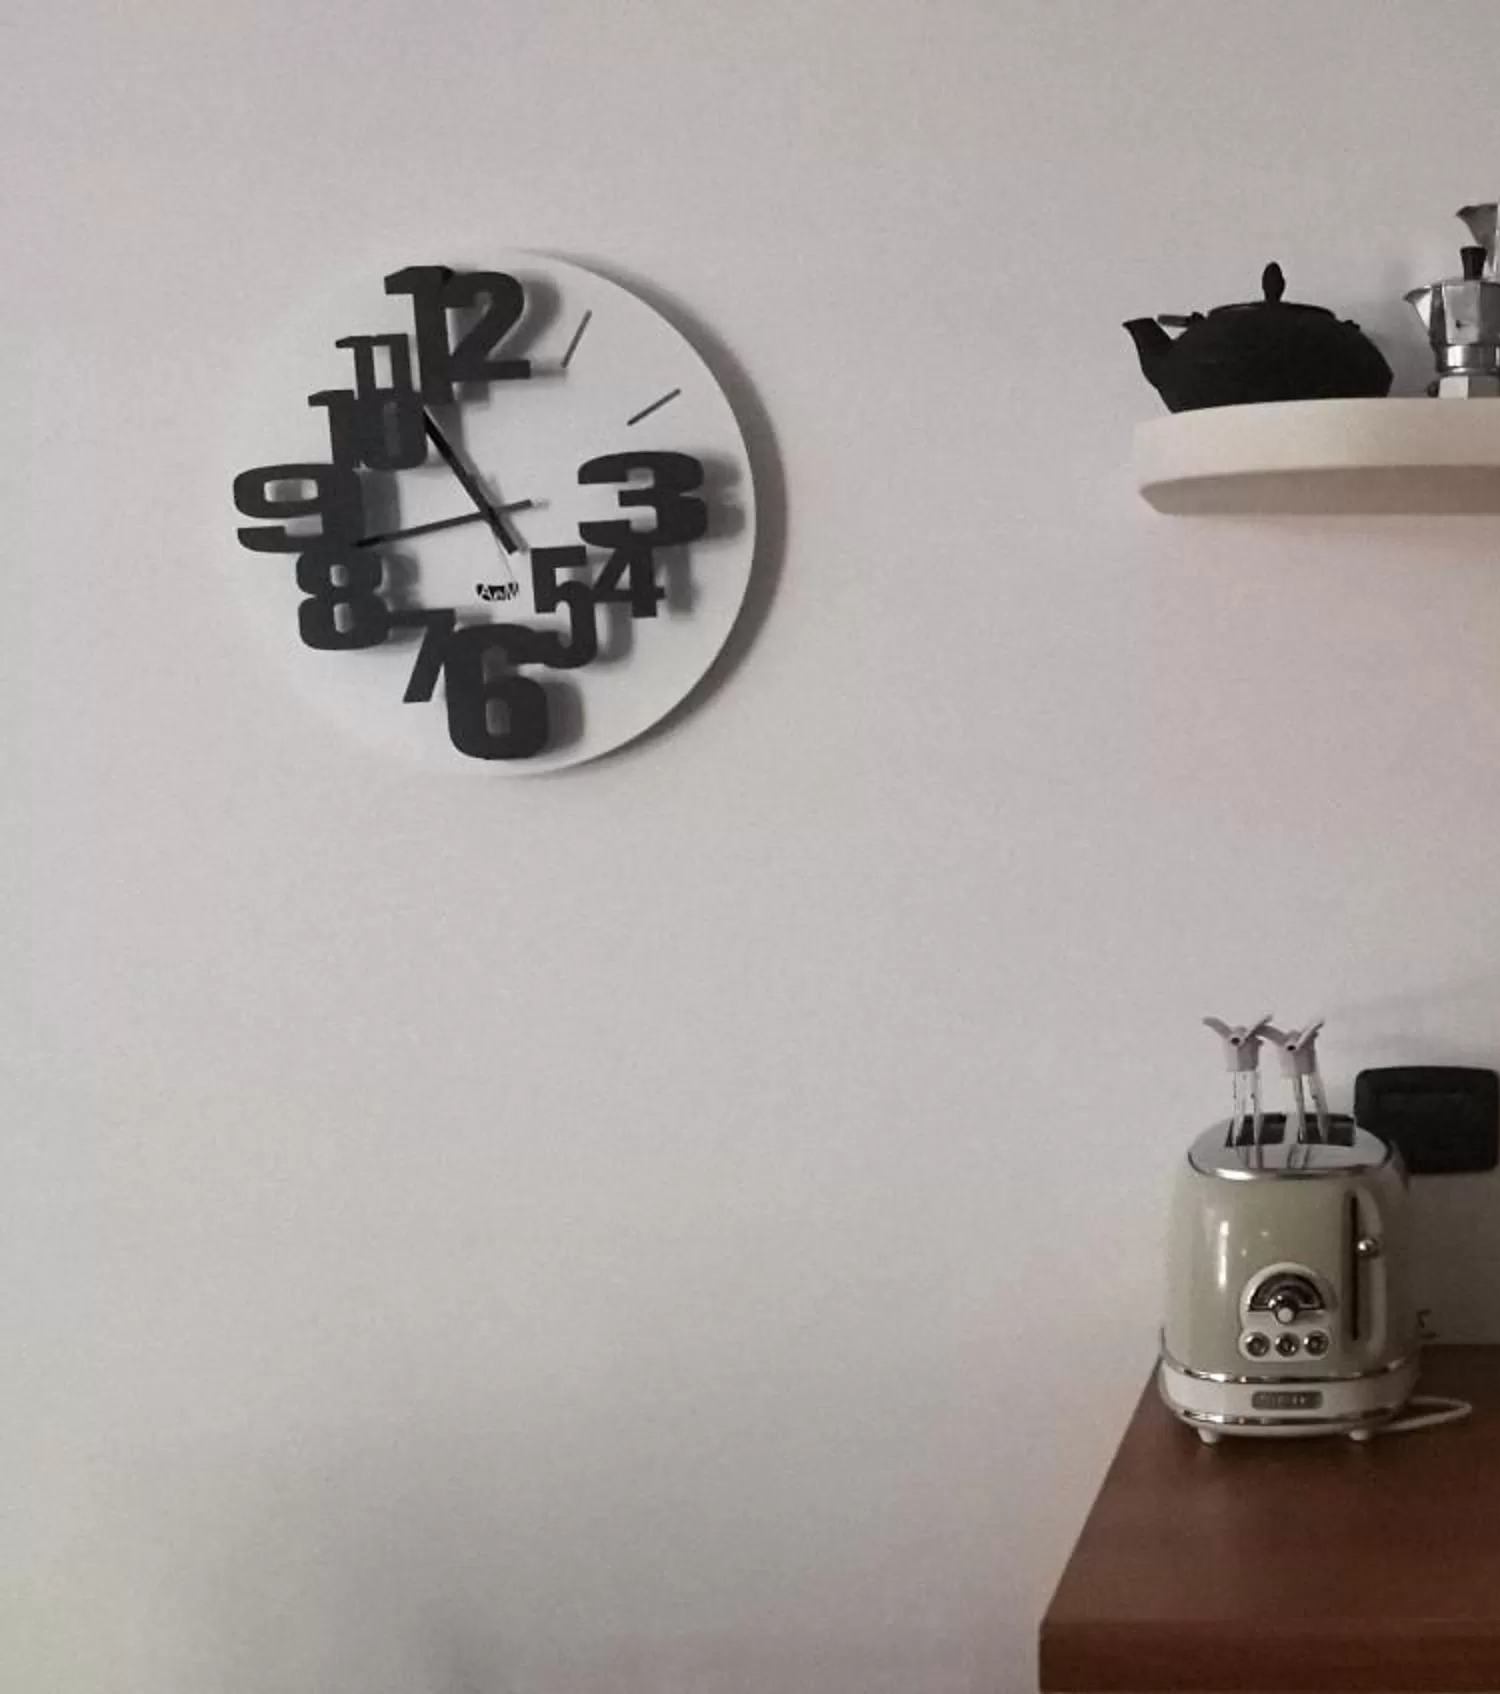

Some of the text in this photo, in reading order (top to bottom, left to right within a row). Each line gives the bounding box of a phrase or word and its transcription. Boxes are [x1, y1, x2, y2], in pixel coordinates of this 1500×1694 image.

[384, 265, 532, 404] 12
[233, 463, 361, 554] 9
[577, 451, 708, 550] 3
[296, 548, 388, 650] 8
[530, 545, 598, 669] 5
[592, 545, 665, 618] 4
[444, 624, 549, 761] 6
